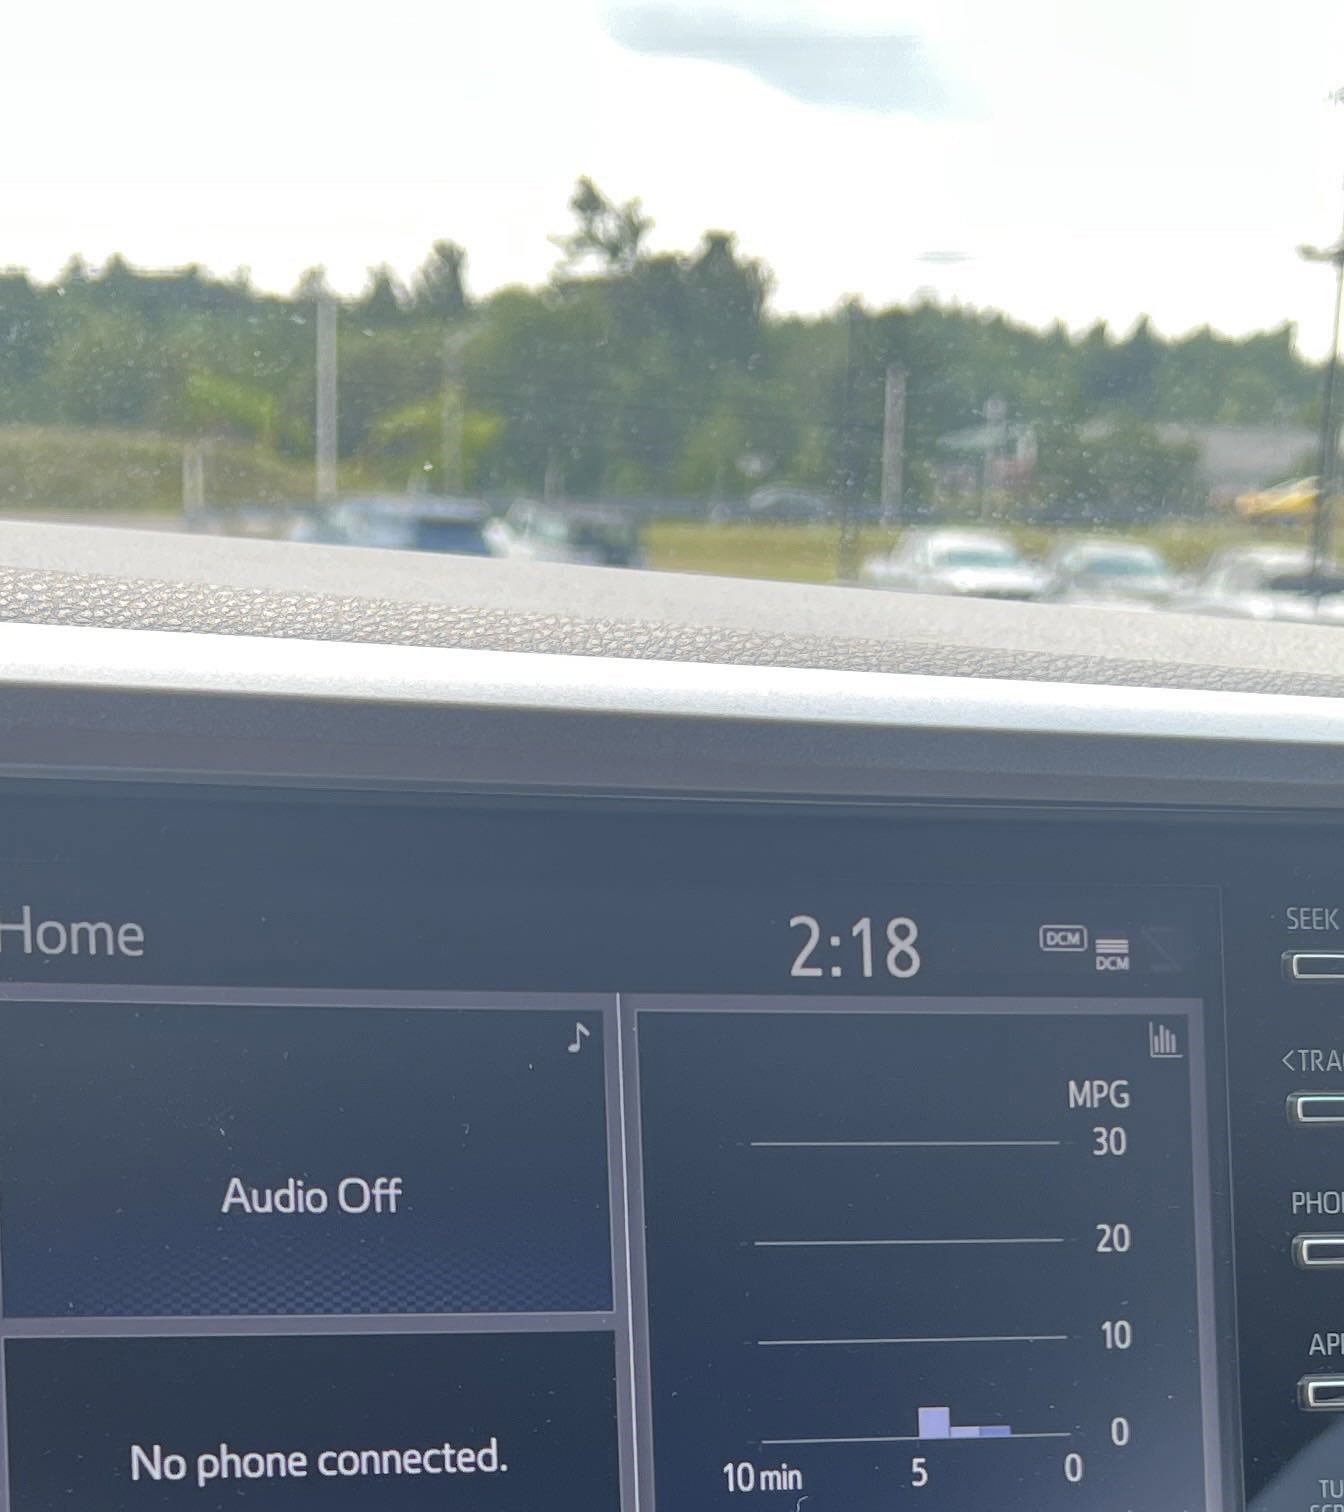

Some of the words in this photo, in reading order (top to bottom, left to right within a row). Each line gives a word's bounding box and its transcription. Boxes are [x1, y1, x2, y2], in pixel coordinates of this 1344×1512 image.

[788, 915, 922, 979] 2:18
[1046, 931, 1080, 946] DCM
[1095, 956, 1129, 970] DCM
[1068, 1079, 1130, 1110] MPG
[1092, 1126, 1127, 1156] 30
[221, 1177, 328, 1215] Audio
[337, 1176, 403, 1214] Off
[1096, 1223, 1131, 1253] 20
[1101, 1321, 1132, 1350] 10
[1111, 1417, 1130, 1447] 0
[130, 1444, 187, 1482] No
[196, 1442, 308, 1487] phone
[317, 1438, 509, 1477] connected.
[910, 1458, 928, 1488] 5
[1064, 1453, 1083, 1483] 0
